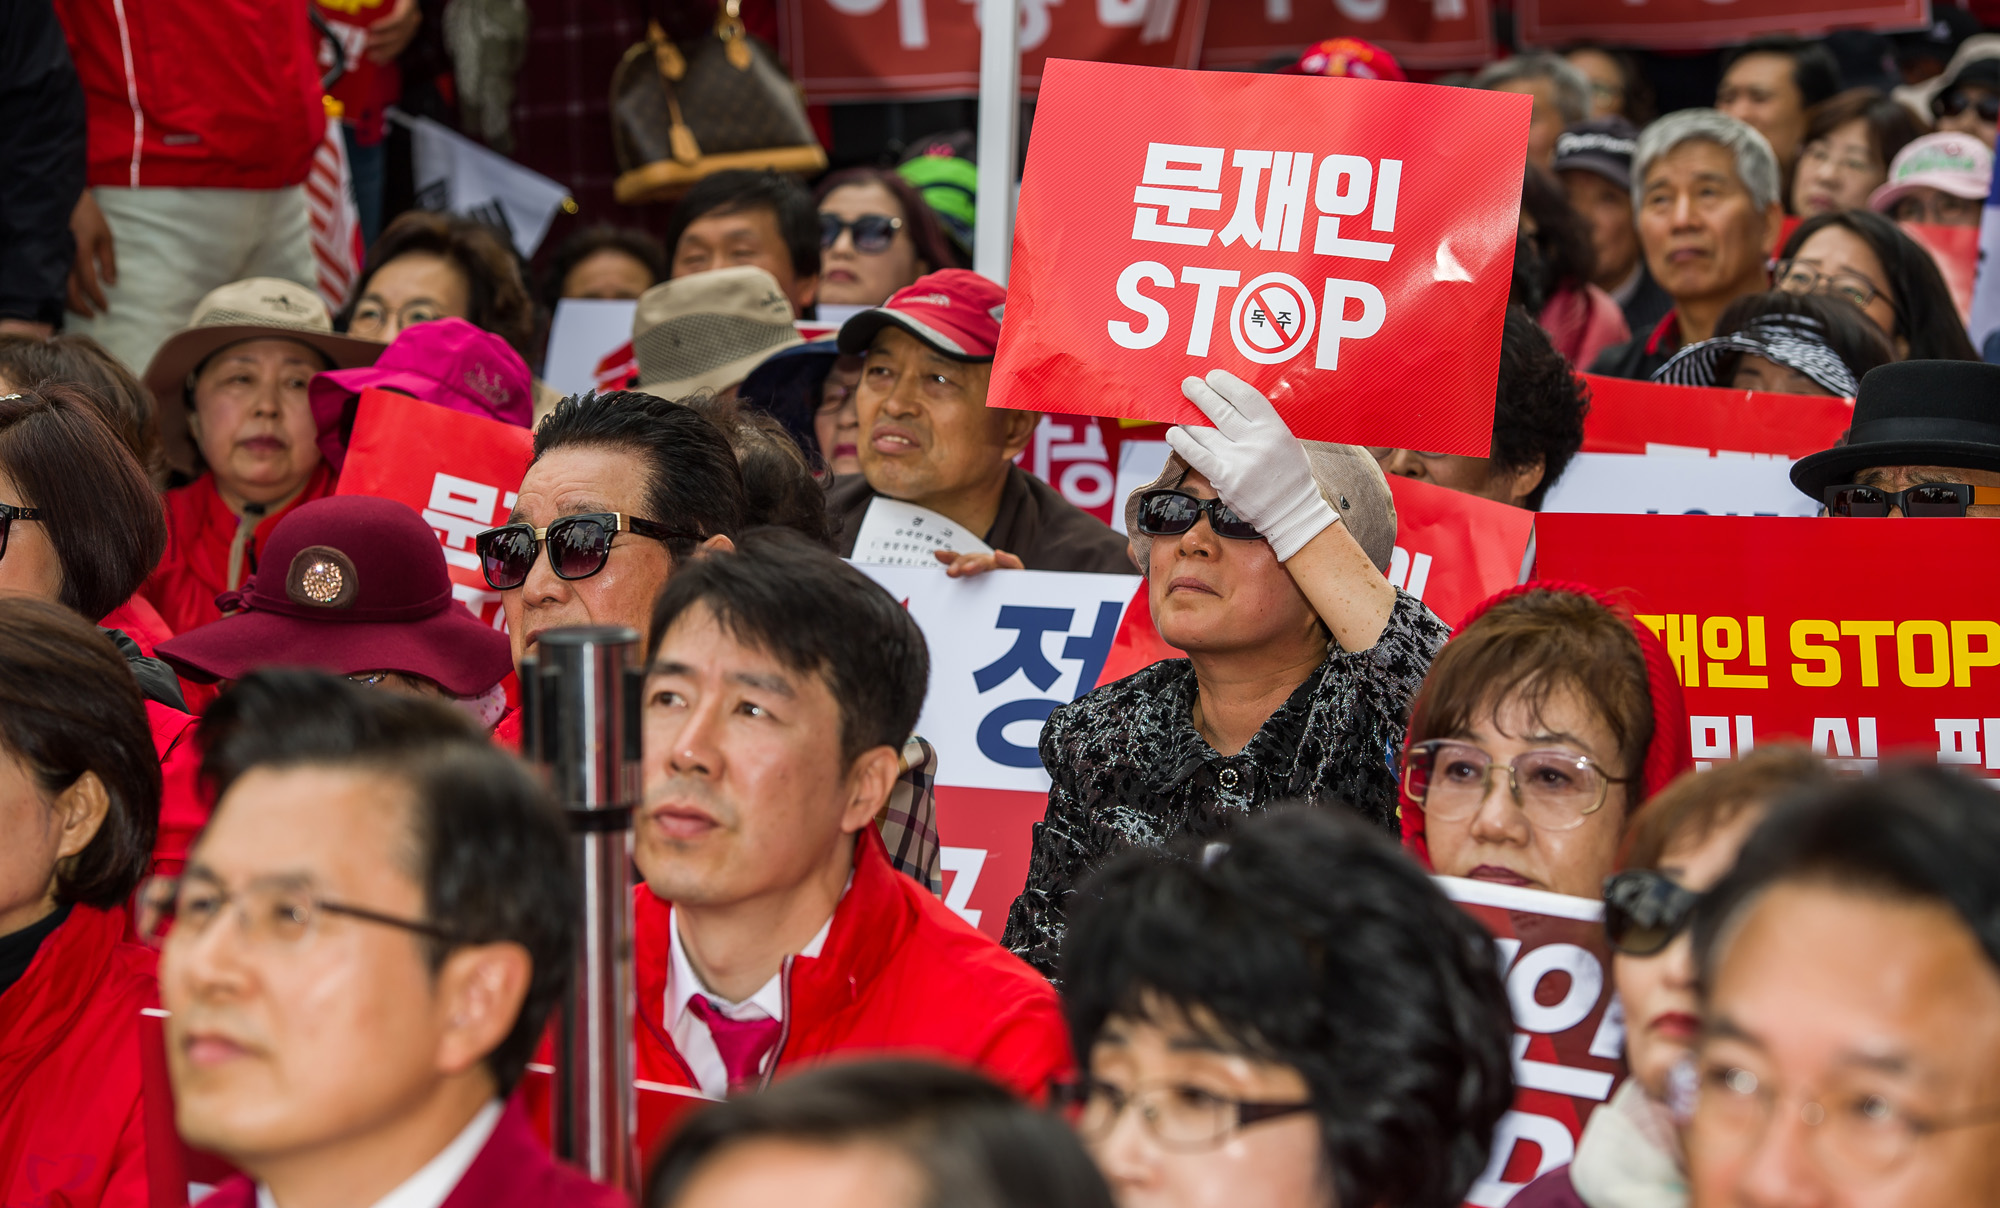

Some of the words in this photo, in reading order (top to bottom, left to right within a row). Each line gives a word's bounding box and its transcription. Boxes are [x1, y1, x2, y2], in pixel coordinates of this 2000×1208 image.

[1131, 142, 1403, 262] 문재인
[1107, 260, 1386, 371] STOP
[1790, 619, 2000, 689] STOP
